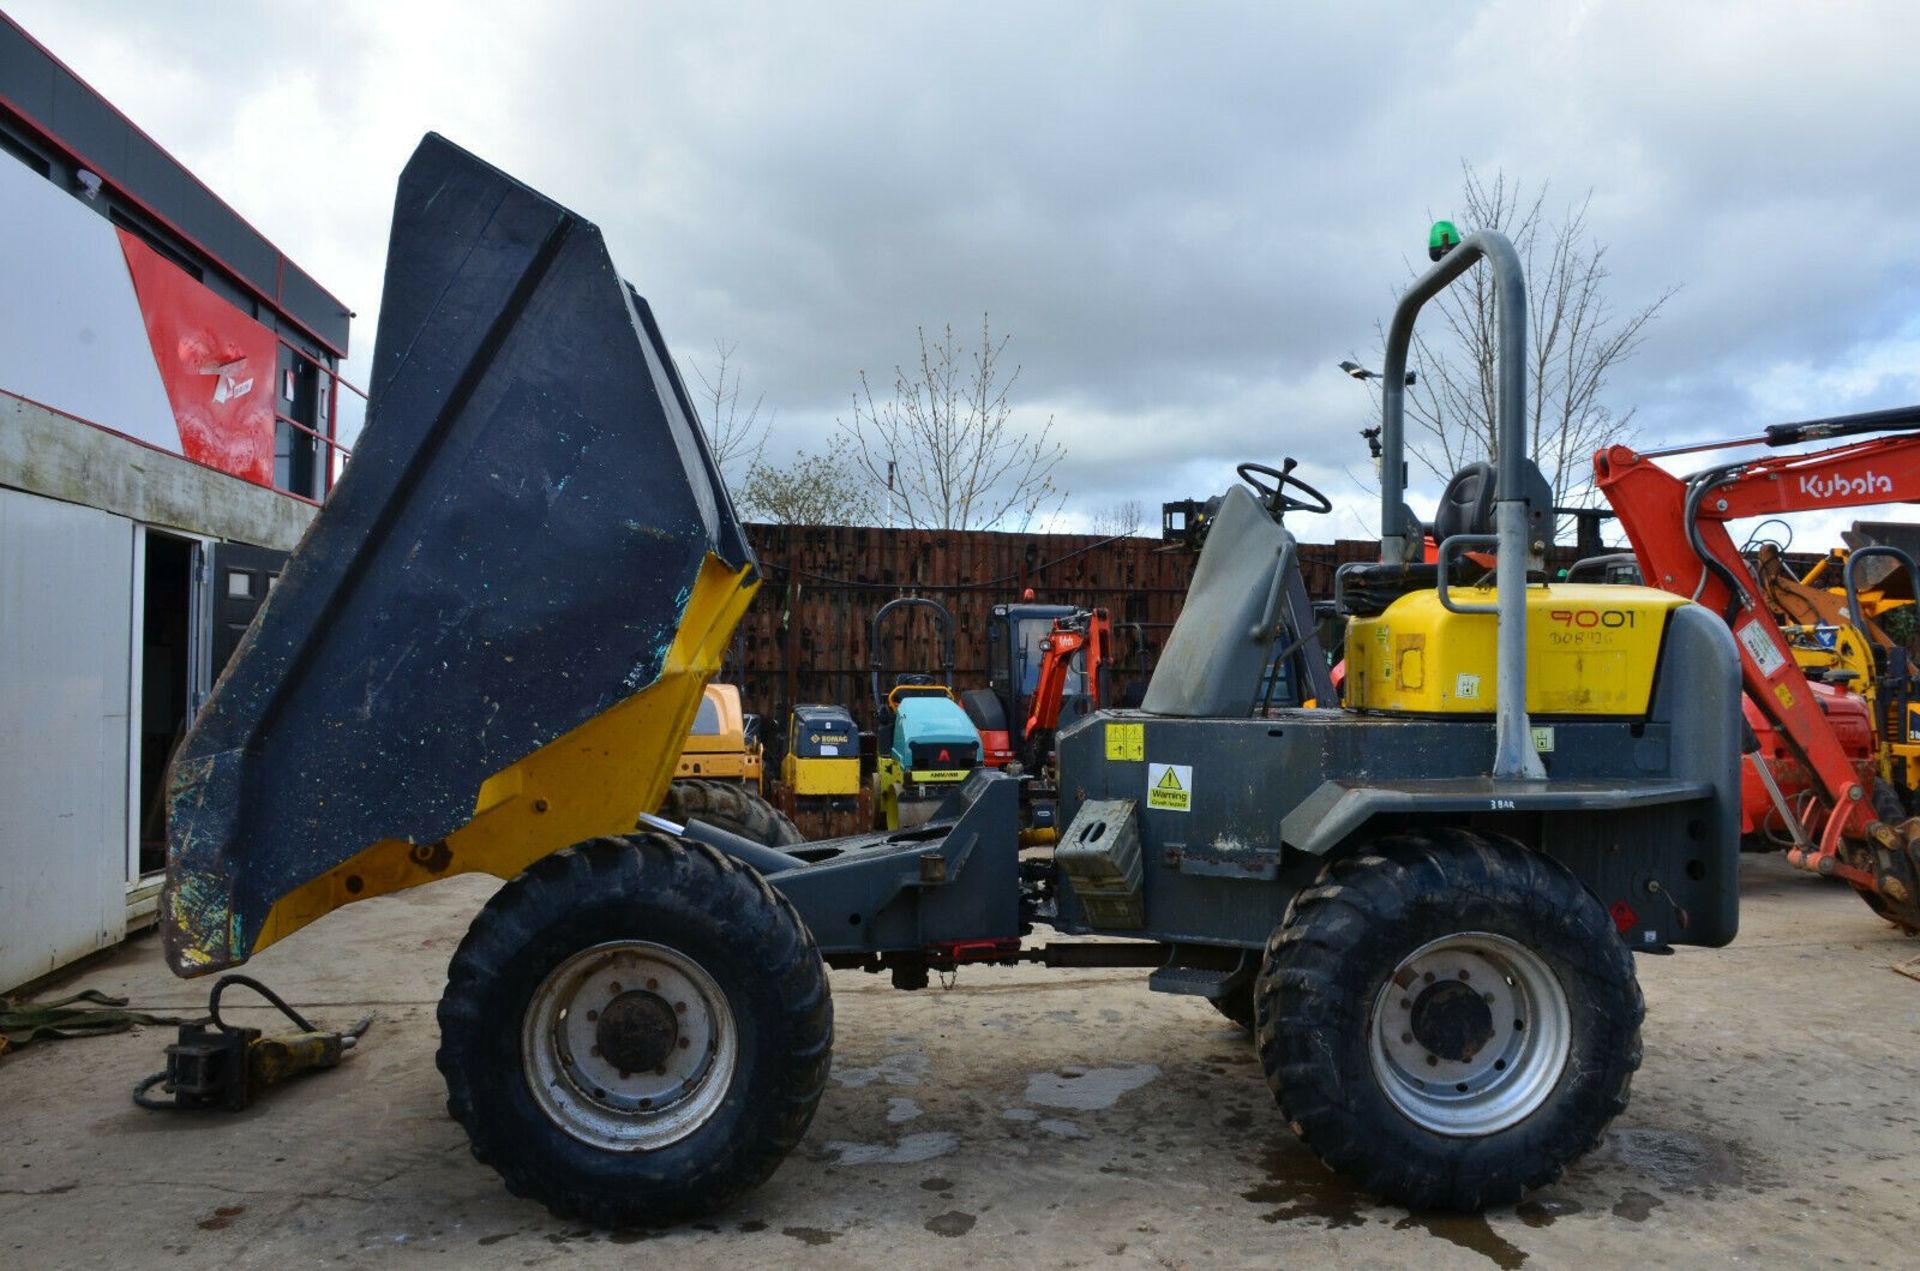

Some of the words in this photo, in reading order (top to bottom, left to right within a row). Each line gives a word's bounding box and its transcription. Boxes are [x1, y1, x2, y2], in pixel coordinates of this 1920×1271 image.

[1800, 470, 1892, 498] Kubota
[1551, 610, 1634, 628] 9001
[1152, 789, 1188, 802] Warning
[1490, 799, 1497, 810] 3
[1497, 800, 1515, 809] BAR
